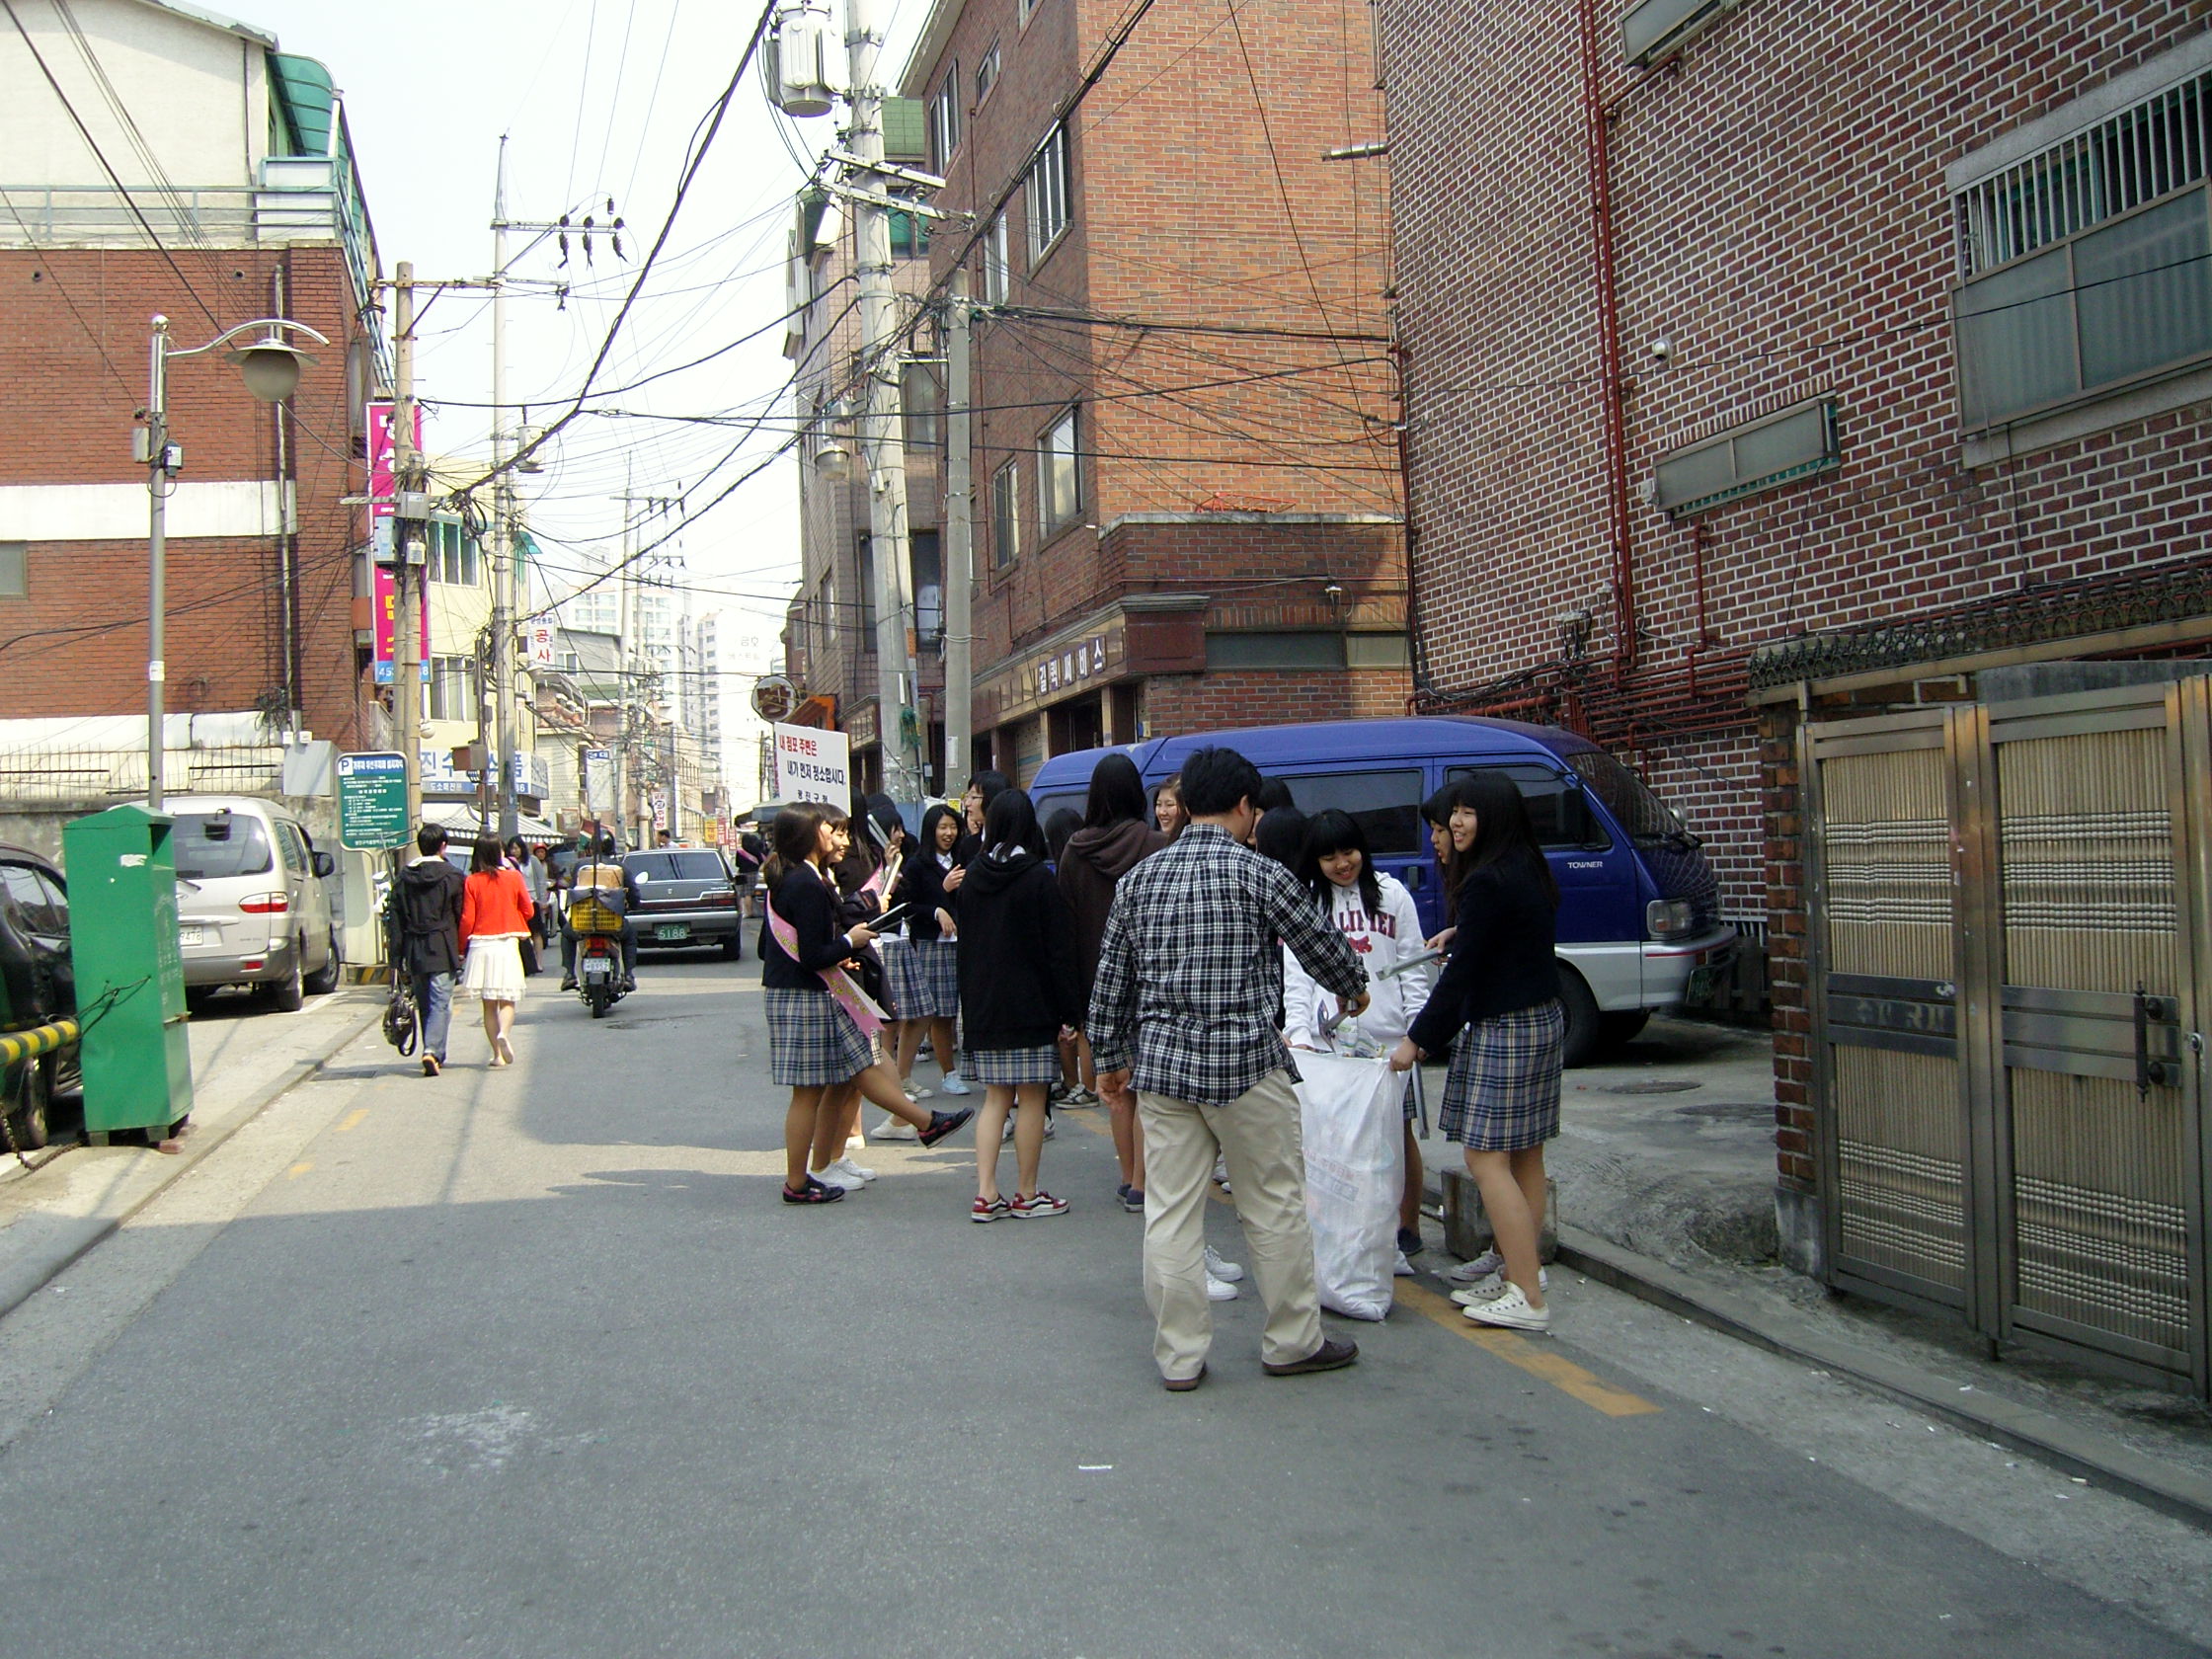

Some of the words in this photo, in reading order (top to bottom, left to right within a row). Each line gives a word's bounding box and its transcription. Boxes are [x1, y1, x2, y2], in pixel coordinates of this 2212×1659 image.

[779, 735, 786, 750] 내
[787, 760, 799, 778] 내가
[800, 761, 812, 780] 먼저
[659, 928, 686, 939] 5188
